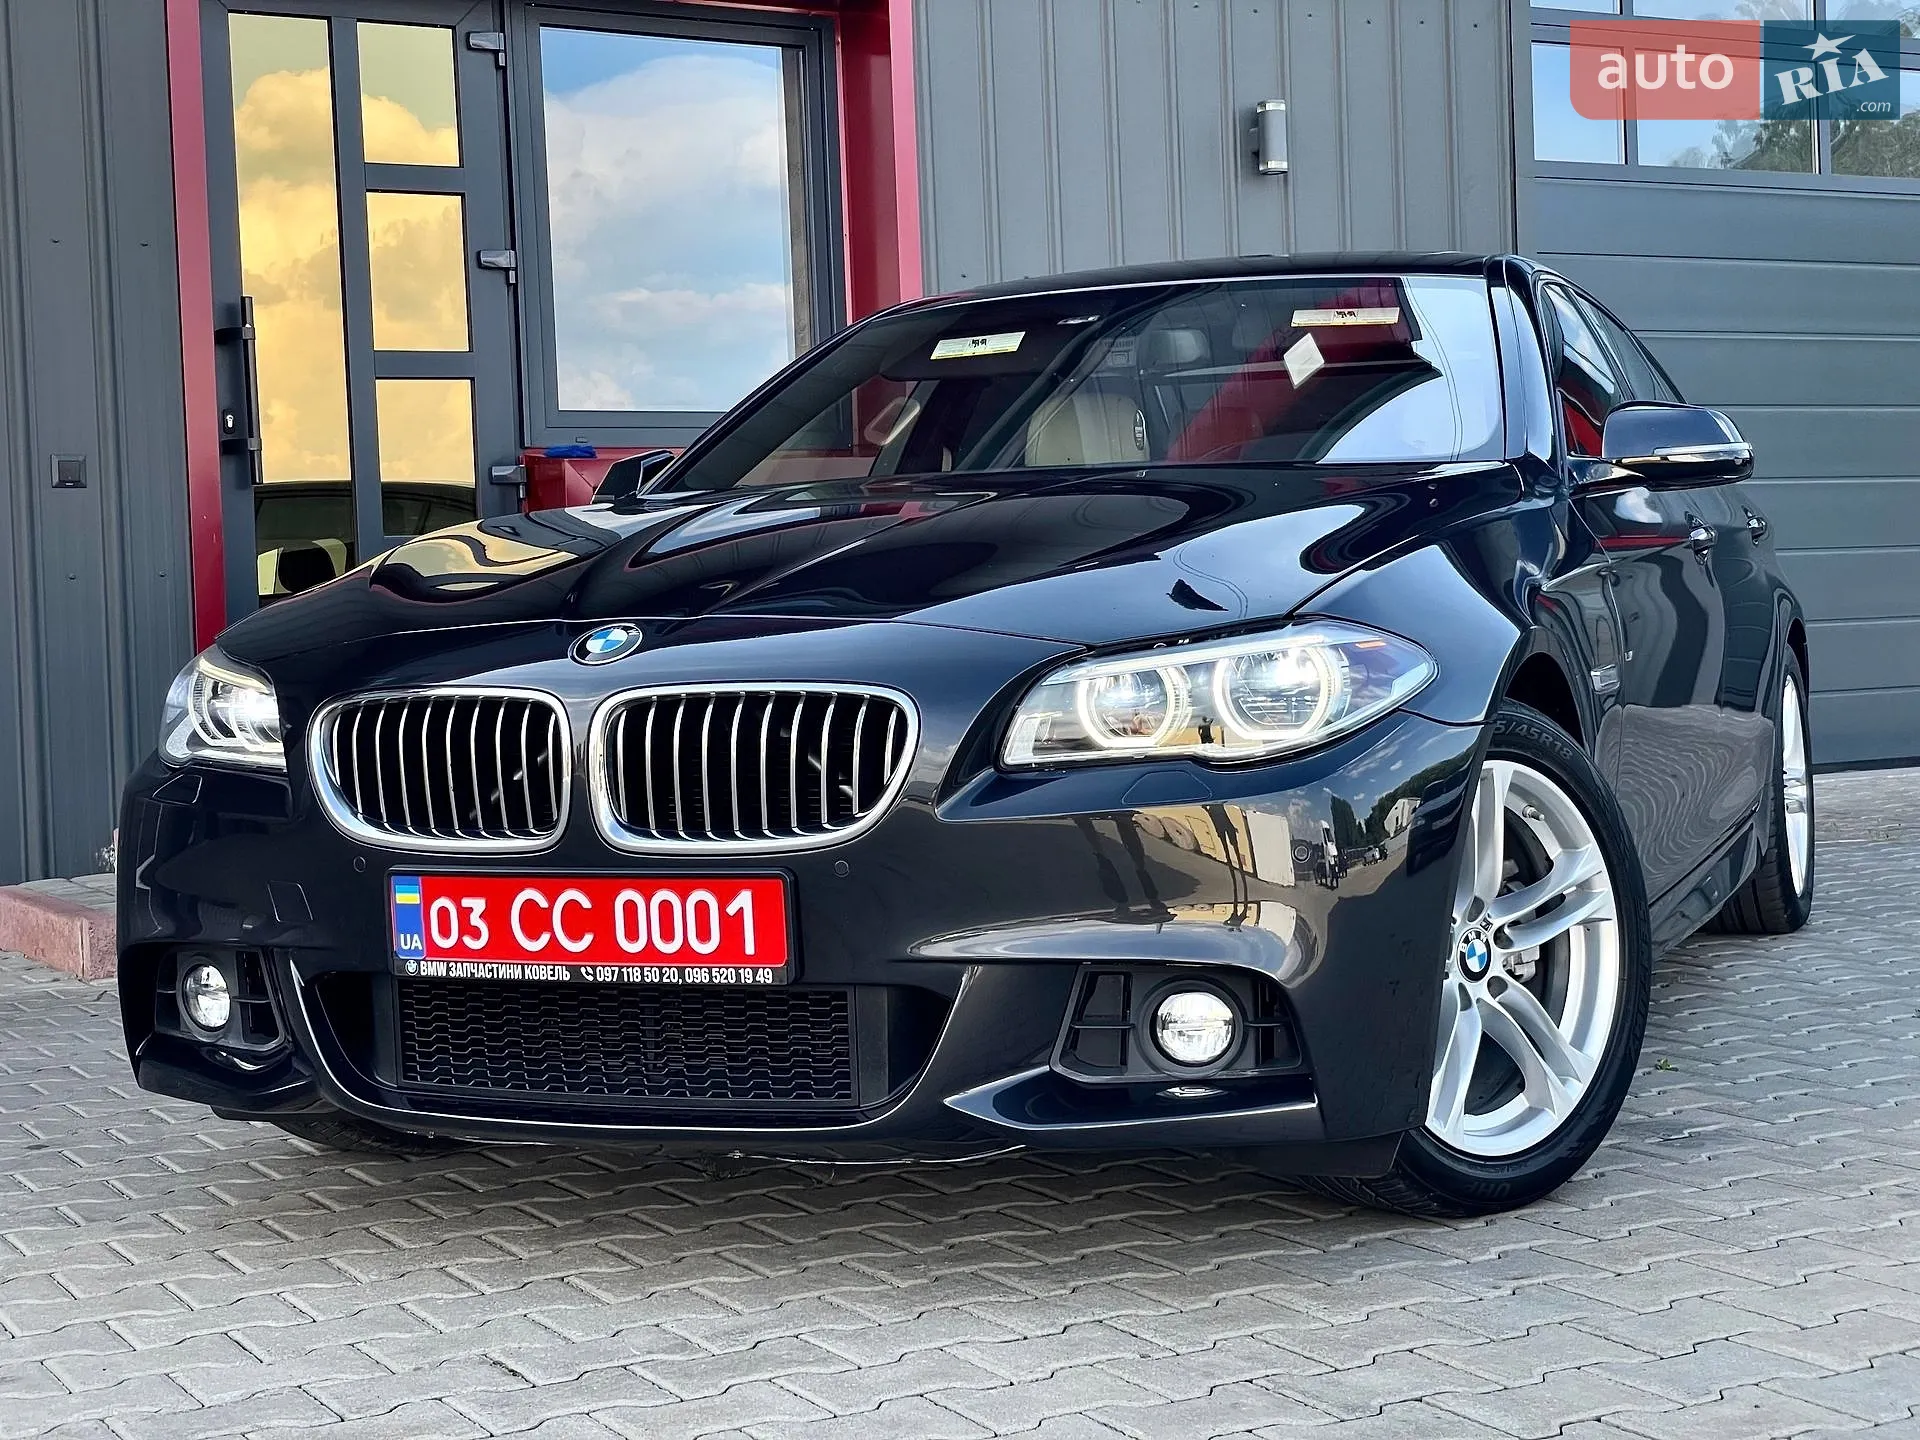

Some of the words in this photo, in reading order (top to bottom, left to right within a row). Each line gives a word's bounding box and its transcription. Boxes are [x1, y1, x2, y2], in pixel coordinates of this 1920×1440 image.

[429, 896, 490, 950] 03
[510, 887, 595, 953] CC
[614, 888, 755, 956] 0001
[400, 933, 423, 950] UA
[1459, 930, 1488, 953] BMW
[420, 961, 447, 977] BMW
[449, 962, 522, 980] ЗАПЧАСТИНИ
[524, 965, 571, 981] КОВЕЛЬ
[596, 966, 619, 982] 097
[620, 966, 641, 982] 118
[644, 967, 660, 983] 50
[662, 967, 682, 985] 20,
[685, 967, 712, 984] 096
[712, 967, 736, 984] 520
[738, 967, 753, 984] 19
[755, 967, 773, 984] 49
